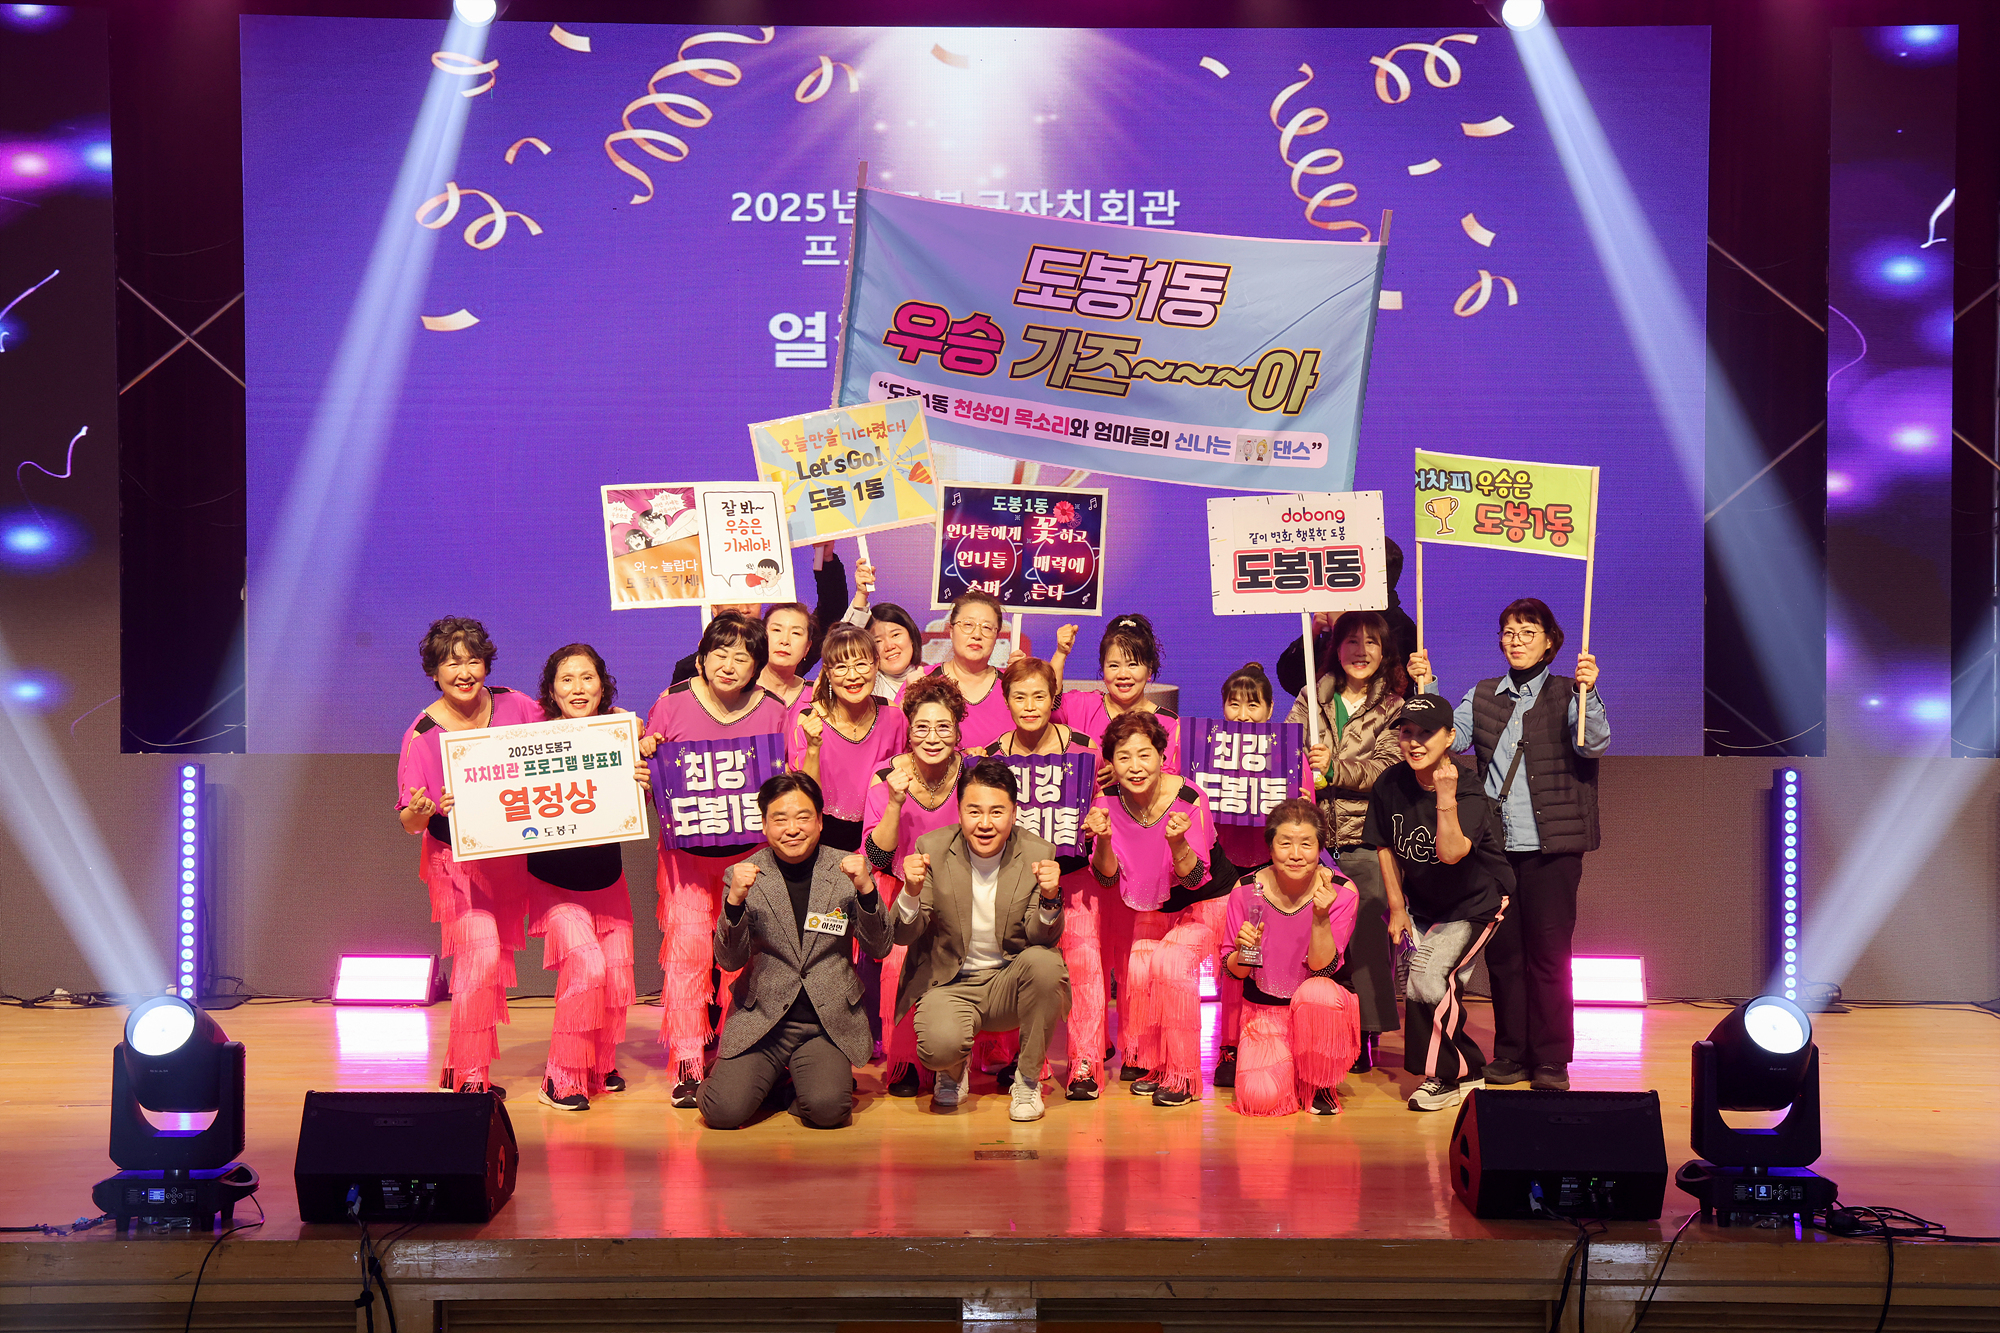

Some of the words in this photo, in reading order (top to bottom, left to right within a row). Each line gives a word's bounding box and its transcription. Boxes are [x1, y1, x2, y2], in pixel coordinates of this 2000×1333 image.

[731, 189, 857, 224] 2025년
[1013, 243, 1232, 329] 도봉1동
[883, 300, 1006, 377] 우승
[781, 428, 838, 453] 오늘만을
[842, 419, 907, 440] 기다렸다!
[954, 398, 1009, 425] 천상의
[1015, 408, 1089, 439] 목소리와
[1095, 421, 1170, 449] 엄마들의
[1175, 433, 1231, 456] 신나는
[808, 485, 847, 512] 도봉
[853, 478, 885, 501] 1동
[1476, 468, 1533, 499] 우승은
[721, 500, 737, 517] 잘
[740, 500, 765, 514] 봐~
[1281, 506, 1345, 524] dobong
[1473, 500, 1574, 547] 도봉1동
[725, 518, 762, 535] 우승은
[946, 523, 1022, 541] 언니들에게
[1249, 532, 1267, 544] 같이
[1296, 527, 1327, 542] 행복한
[1331, 526, 1346, 541] 도봉
[724, 537, 771, 552] 기세야!
[634, 561, 647, 573] 와
[661, 559, 698, 572] 놀랍다
[957, 551, 1008, 569] 언니들
[1033, 555, 1086, 574] 매력에
[1234, 546, 1365, 593] 도봉1동
[671, 574, 700, 588] 기세!
[1031, 583, 1065, 601] 든다
[508, 743, 543, 758] 2025년
[545, 740, 572, 754] 도봉구
[1213, 730, 1268, 771] 최강
[464, 762, 520, 783] 자치회관
[524, 755, 578, 777] 프로그램
[582, 750, 622, 770] 발표회
[684, 749, 746, 791] 최강
[498, 778, 597, 823] 열정상
[1195, 772, 1288, 815] 도봉1동
[544, 823, 577, 837] 도봉구
[671, 791, 763, 837] 도봉1동
[1015, 805, 1080, 846] 봉1동
